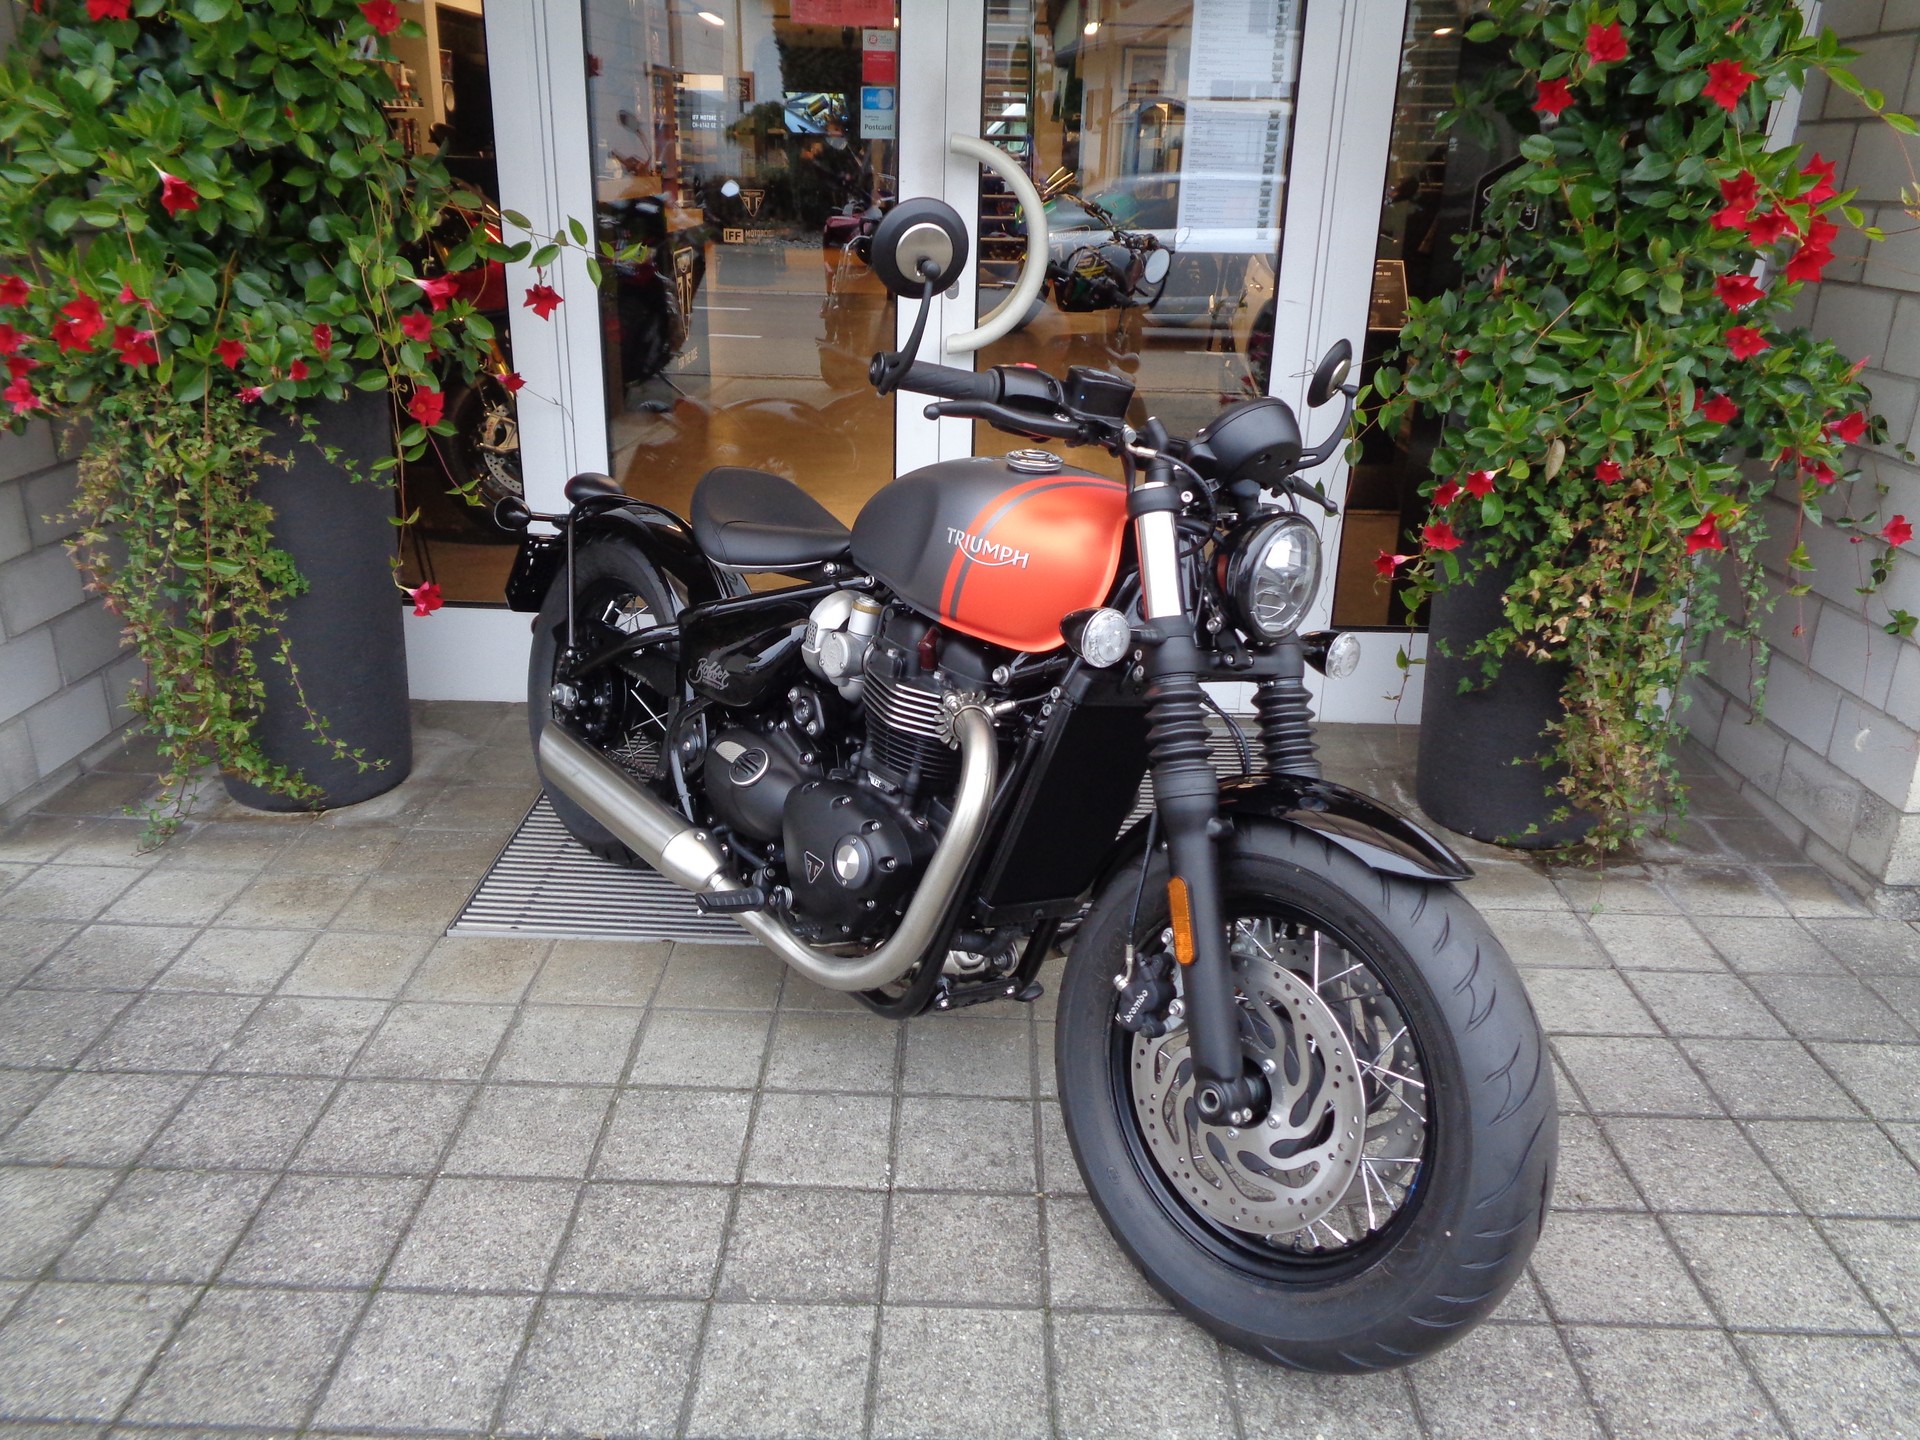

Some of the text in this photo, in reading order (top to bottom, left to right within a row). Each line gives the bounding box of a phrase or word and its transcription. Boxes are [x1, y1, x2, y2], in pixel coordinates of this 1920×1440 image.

[864, 123, 892, 131] Postcard
[725, 230, 742, 241] IFF
[947, 527, 1029, 569] TRIUMPH
[688, 657, 730, 690] Bobber
[1123, 989, 1149, 1023] brembo
